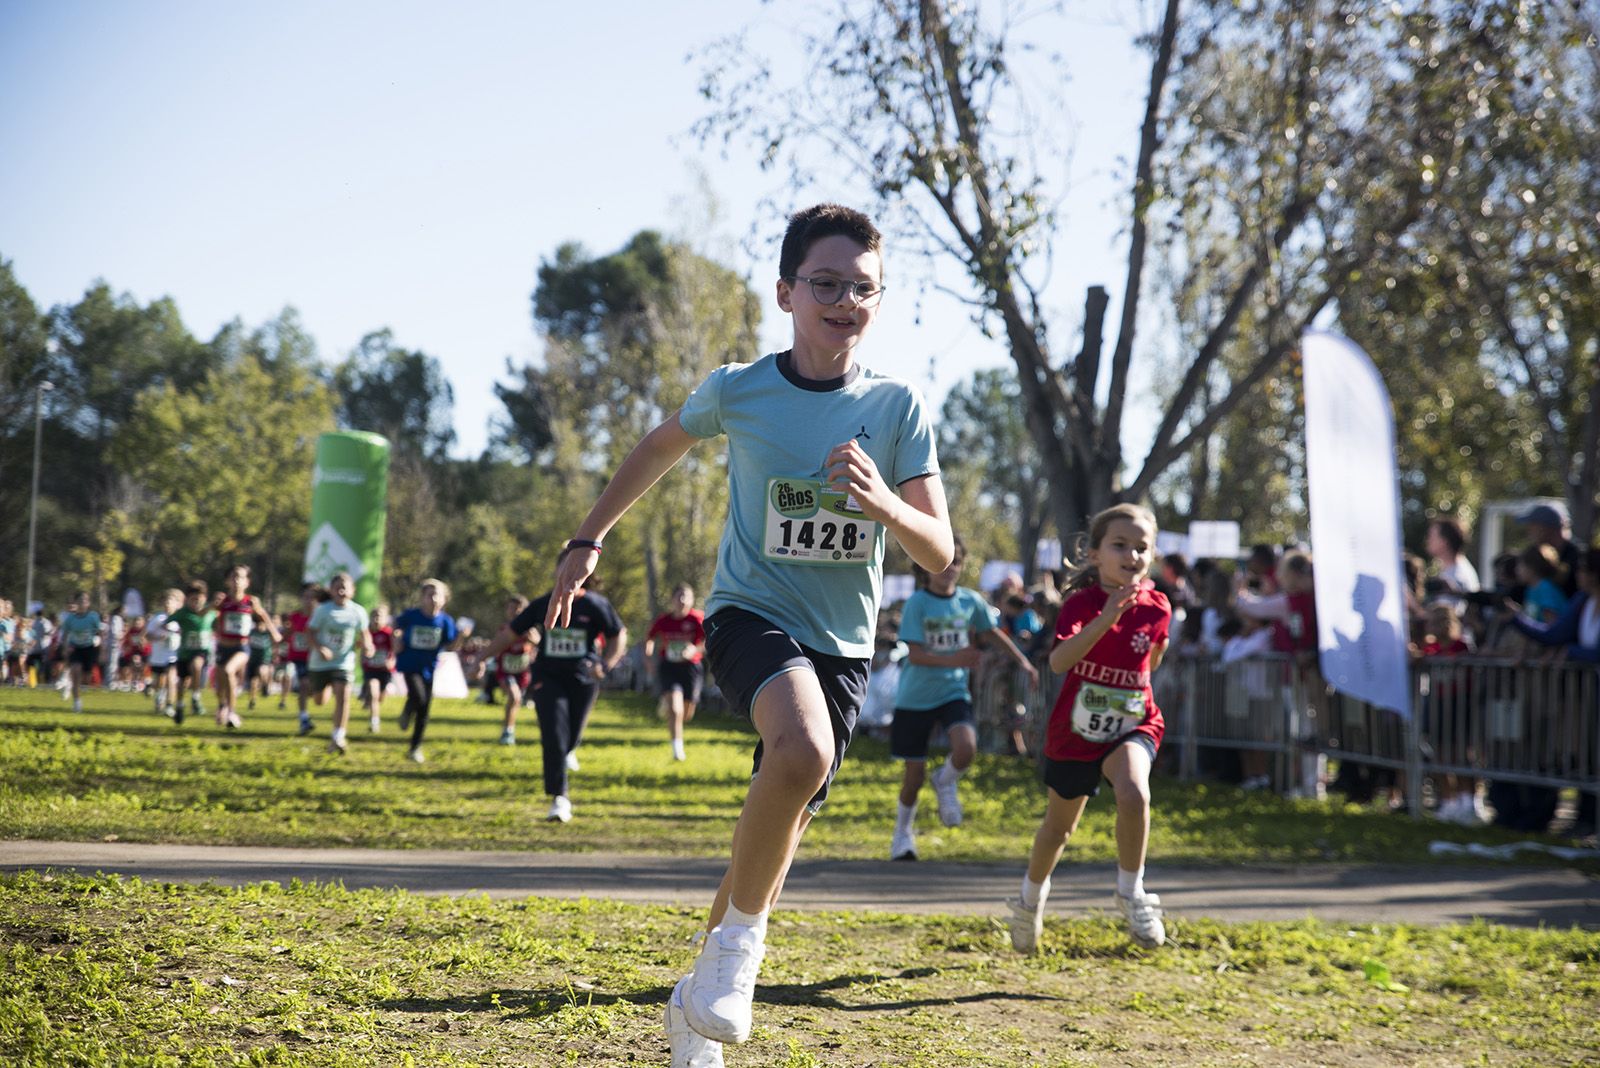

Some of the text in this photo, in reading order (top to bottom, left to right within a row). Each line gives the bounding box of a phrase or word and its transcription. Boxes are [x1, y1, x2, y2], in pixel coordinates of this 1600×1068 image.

[778, 491, 814, 508] CROS
[779, 519, 858, 551] 1428
[1088, 713, 1124, 733] 521
